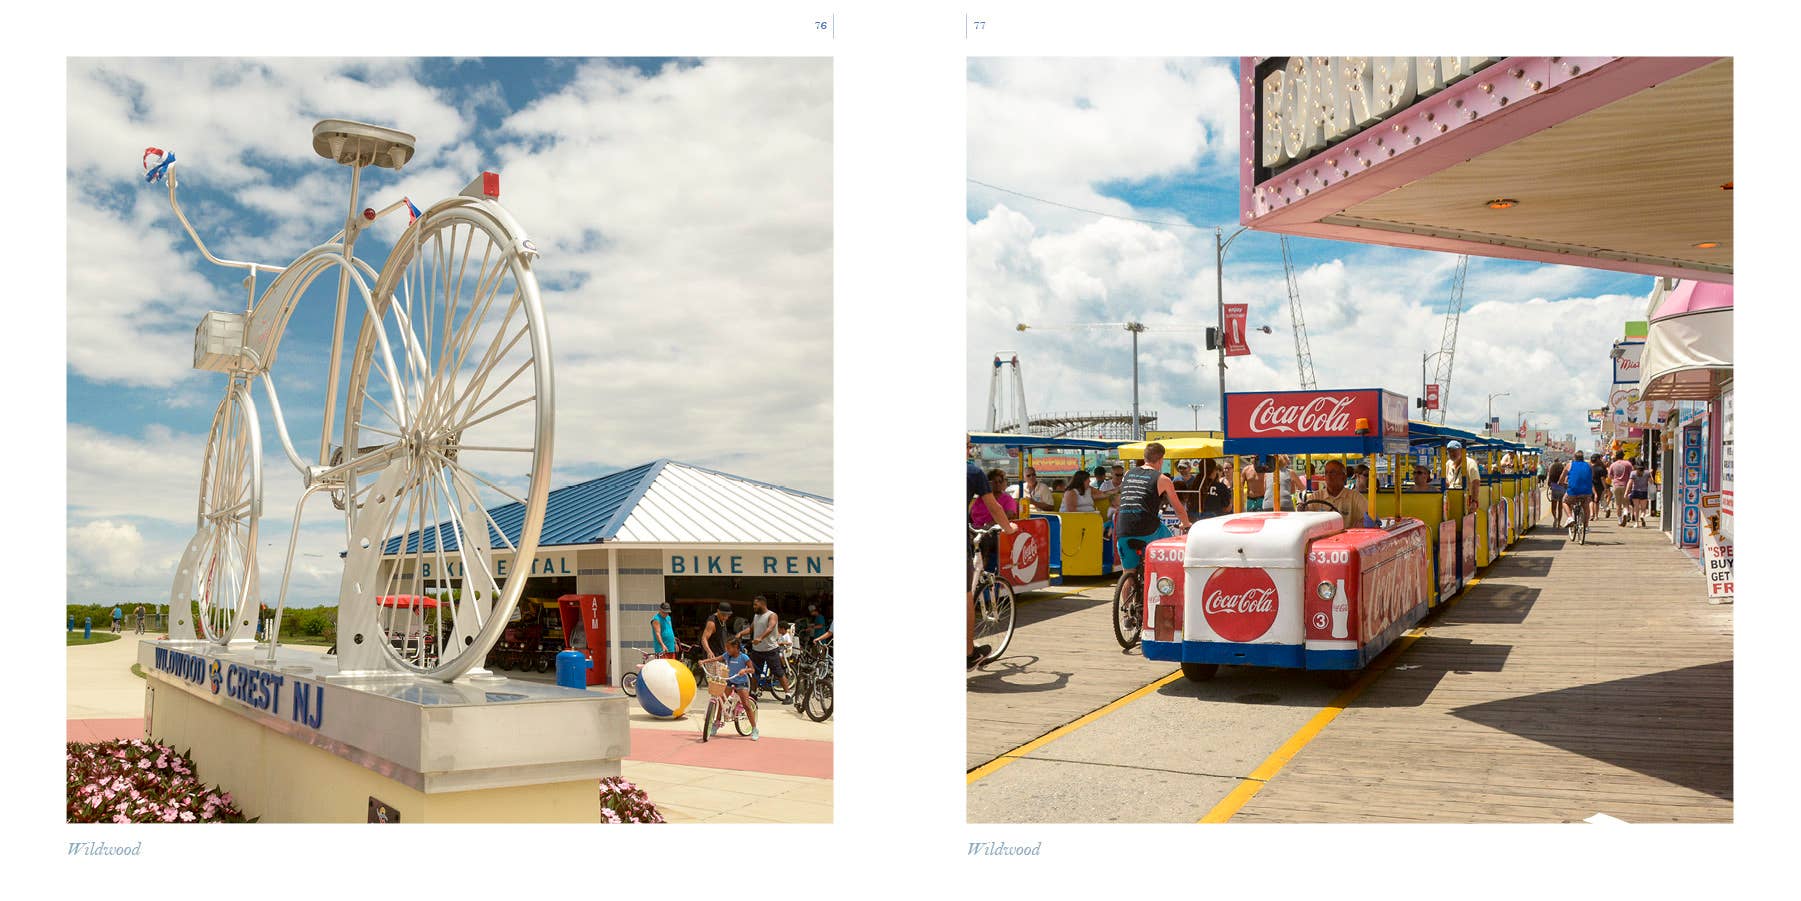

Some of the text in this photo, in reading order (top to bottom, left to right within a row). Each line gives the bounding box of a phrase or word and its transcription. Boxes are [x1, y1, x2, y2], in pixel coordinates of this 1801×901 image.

[1250, 396, 1356, 433] Coca-Cola
[671, 555, 833, 574] BIKE REN
[1149, 548, 1185, 562] $3.00
[1309, 551, 1349, 564] $3.00
[1711, 559, 1733, 569] BUY
[1711, 571, 1730, 582] GET
[1205, 587, 1277, 615] Coca-Cola
[591, 597, 599, 630] ATM
[155, 646, 324, 730] WILDWOOD CREST NJ
